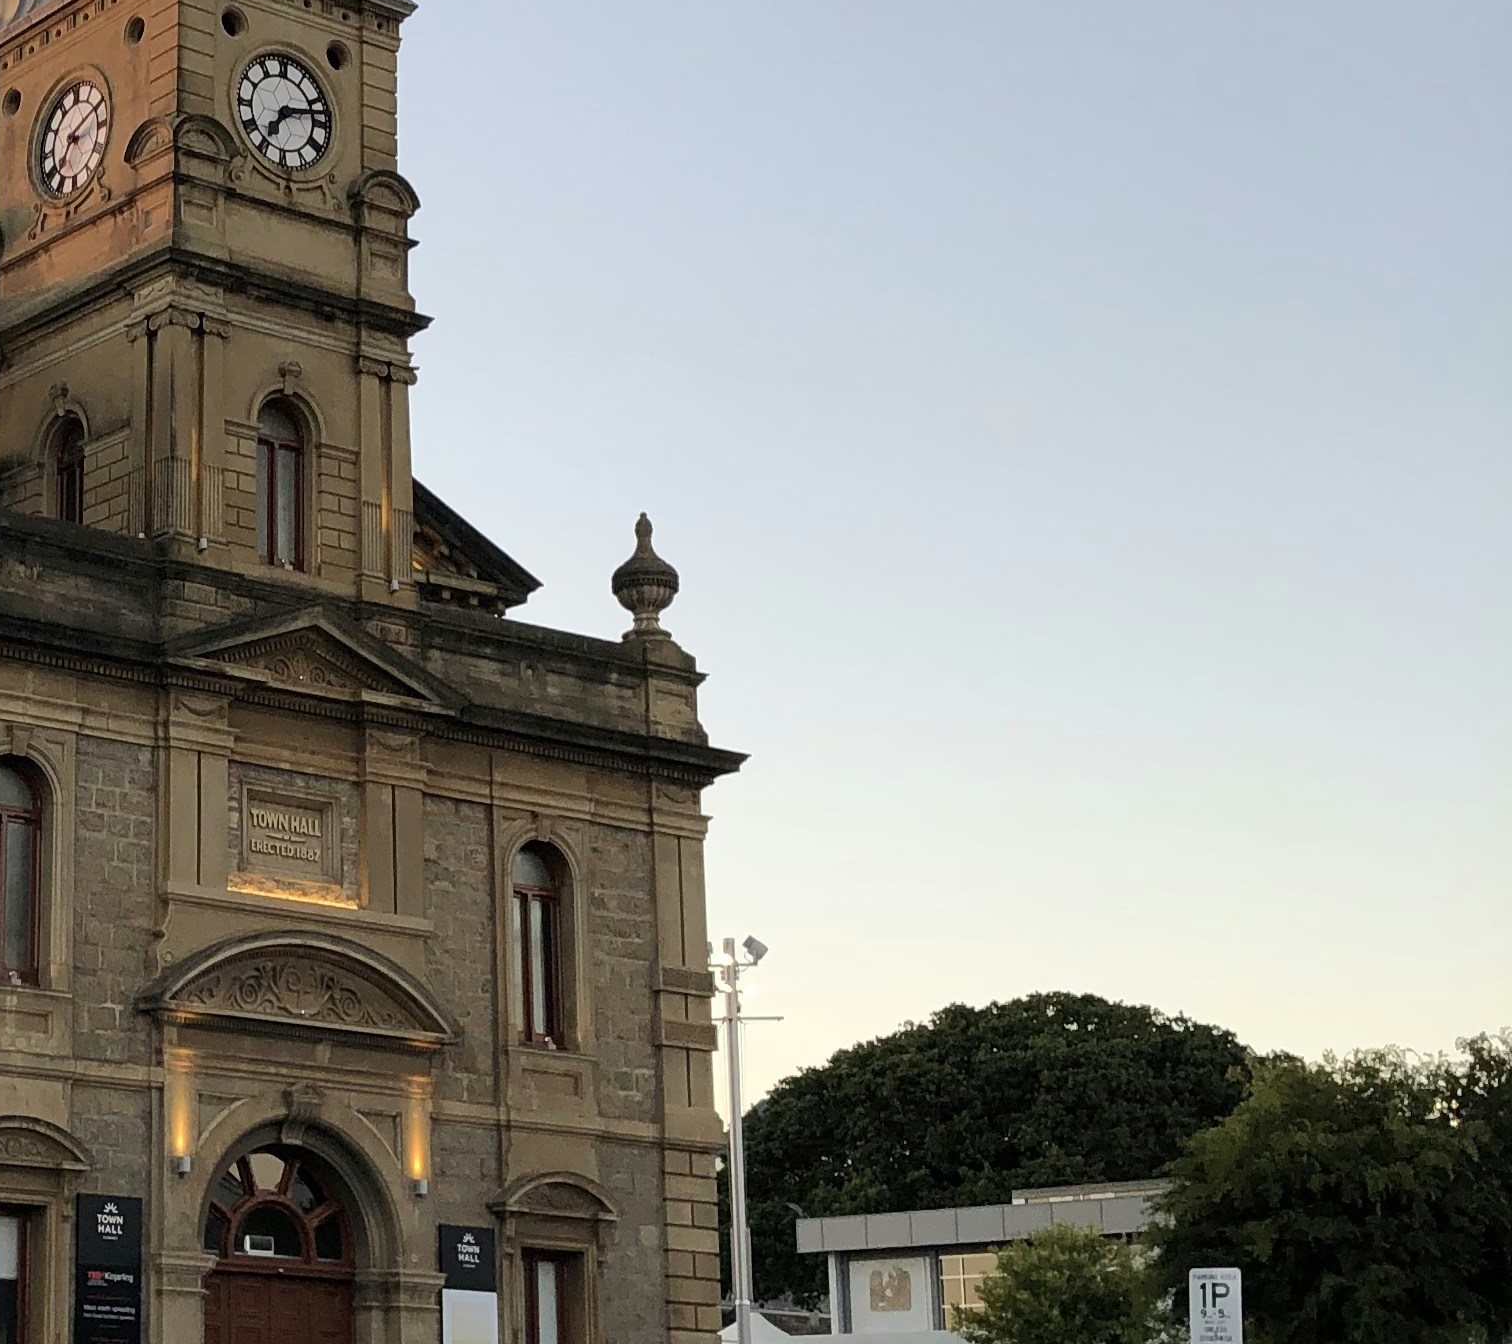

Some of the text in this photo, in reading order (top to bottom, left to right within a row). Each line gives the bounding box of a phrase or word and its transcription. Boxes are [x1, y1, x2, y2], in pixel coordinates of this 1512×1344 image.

[250, 807, 322, 837] TOWN HALL
[96, 1213, 124, 1225] TOWN
[97, 1224, 123, 1235] HALL
[456, 1243, 480, 1254] TOWN
[457, 1253, 480, 1263] HALL
[1199, 1282, 1231, 1309] 1P
